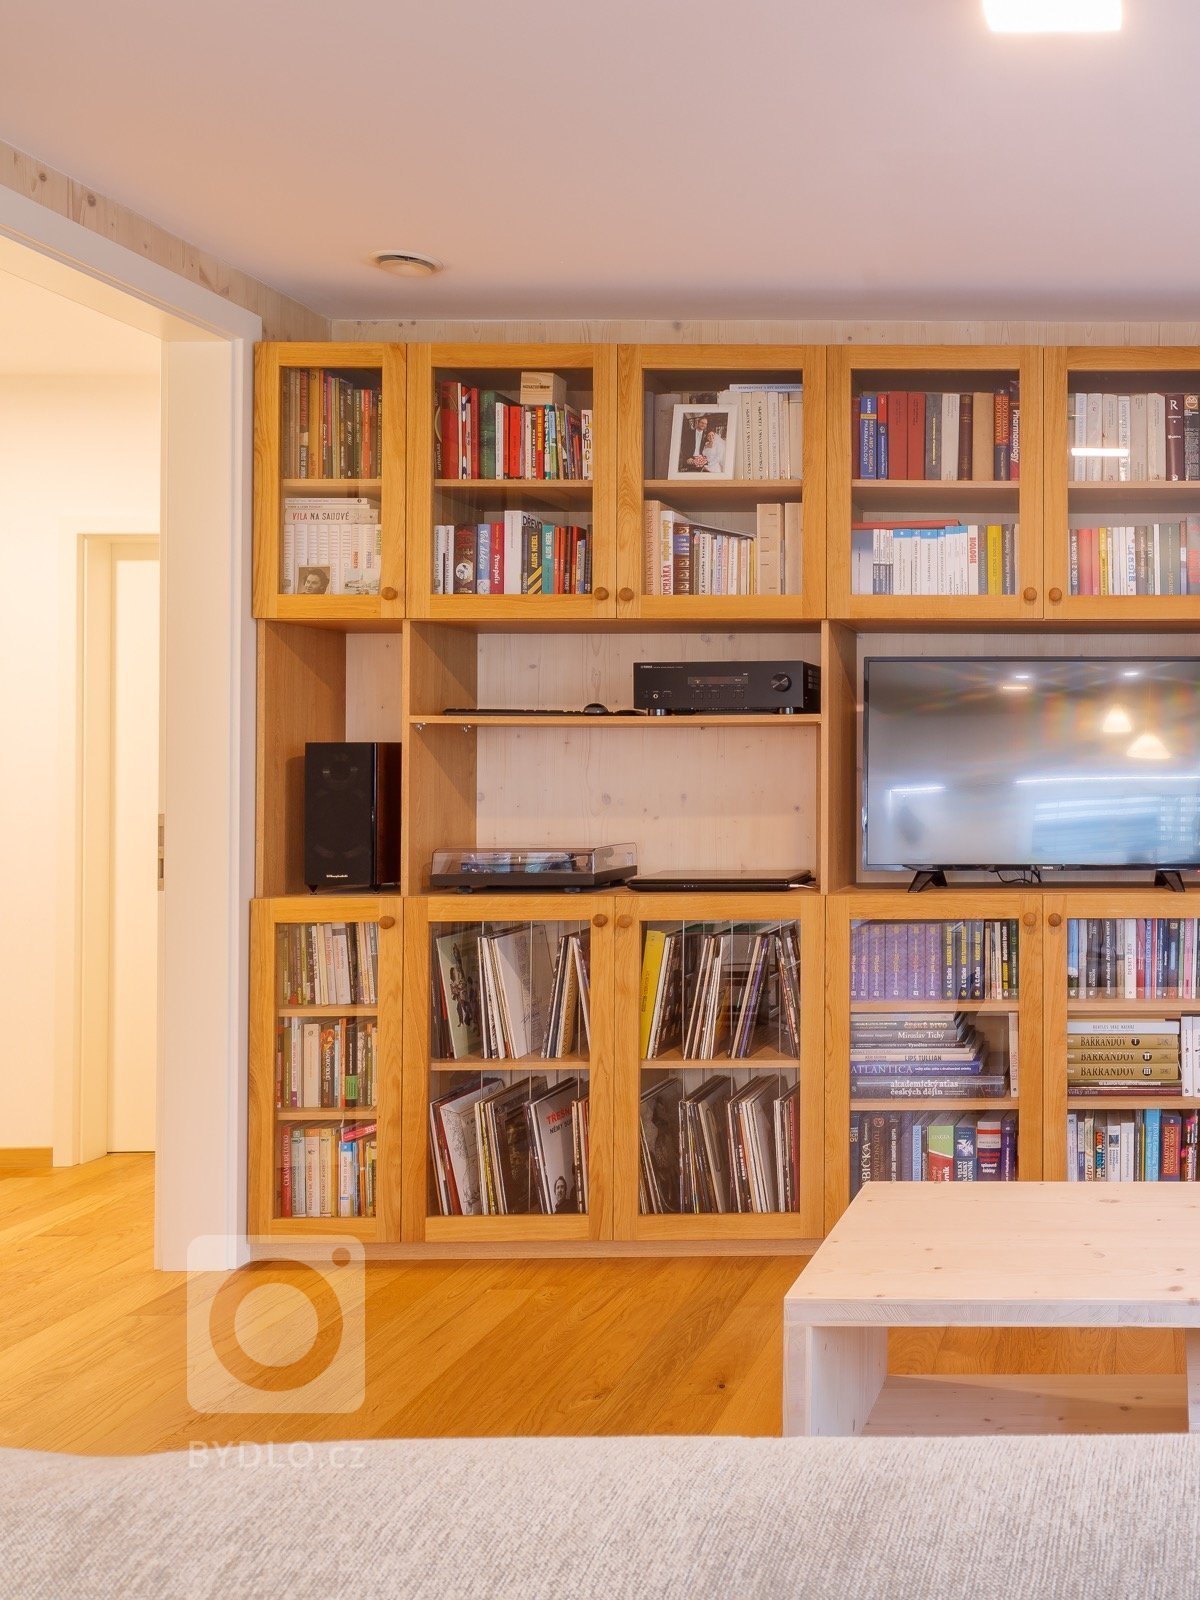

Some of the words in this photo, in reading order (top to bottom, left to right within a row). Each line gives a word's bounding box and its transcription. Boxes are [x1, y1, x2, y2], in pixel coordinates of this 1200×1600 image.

[1170, 399, 1180, 411] R
[1011, 409, 1020, 464] Pharmacology
[293, 513, 308, 521] VILA
[310, 513, 320, 521] NA
[322, 511, 350, 521] SADOVÉ
[494, 554, 502, 585] Persepolis
[897, 1031, 926, 1040] Miroslav
[927, 1031, 945, 1041] Tichý
[1080, 1037, 1127, 1046] BARRANDOV
[1080, 1052, 1135, 1061] BARRANDOV
[851, 1065, 915, 1074] ATLANTICA
[1080, 1067, 1135, 1076] BARRANDOV
[890, 1080, 937, 1089] akademický
[939, 1080, 959, 1088] atlas
[890, 1087, 921, 1096] českých
[923, 1087, 943, 1097] dějin
